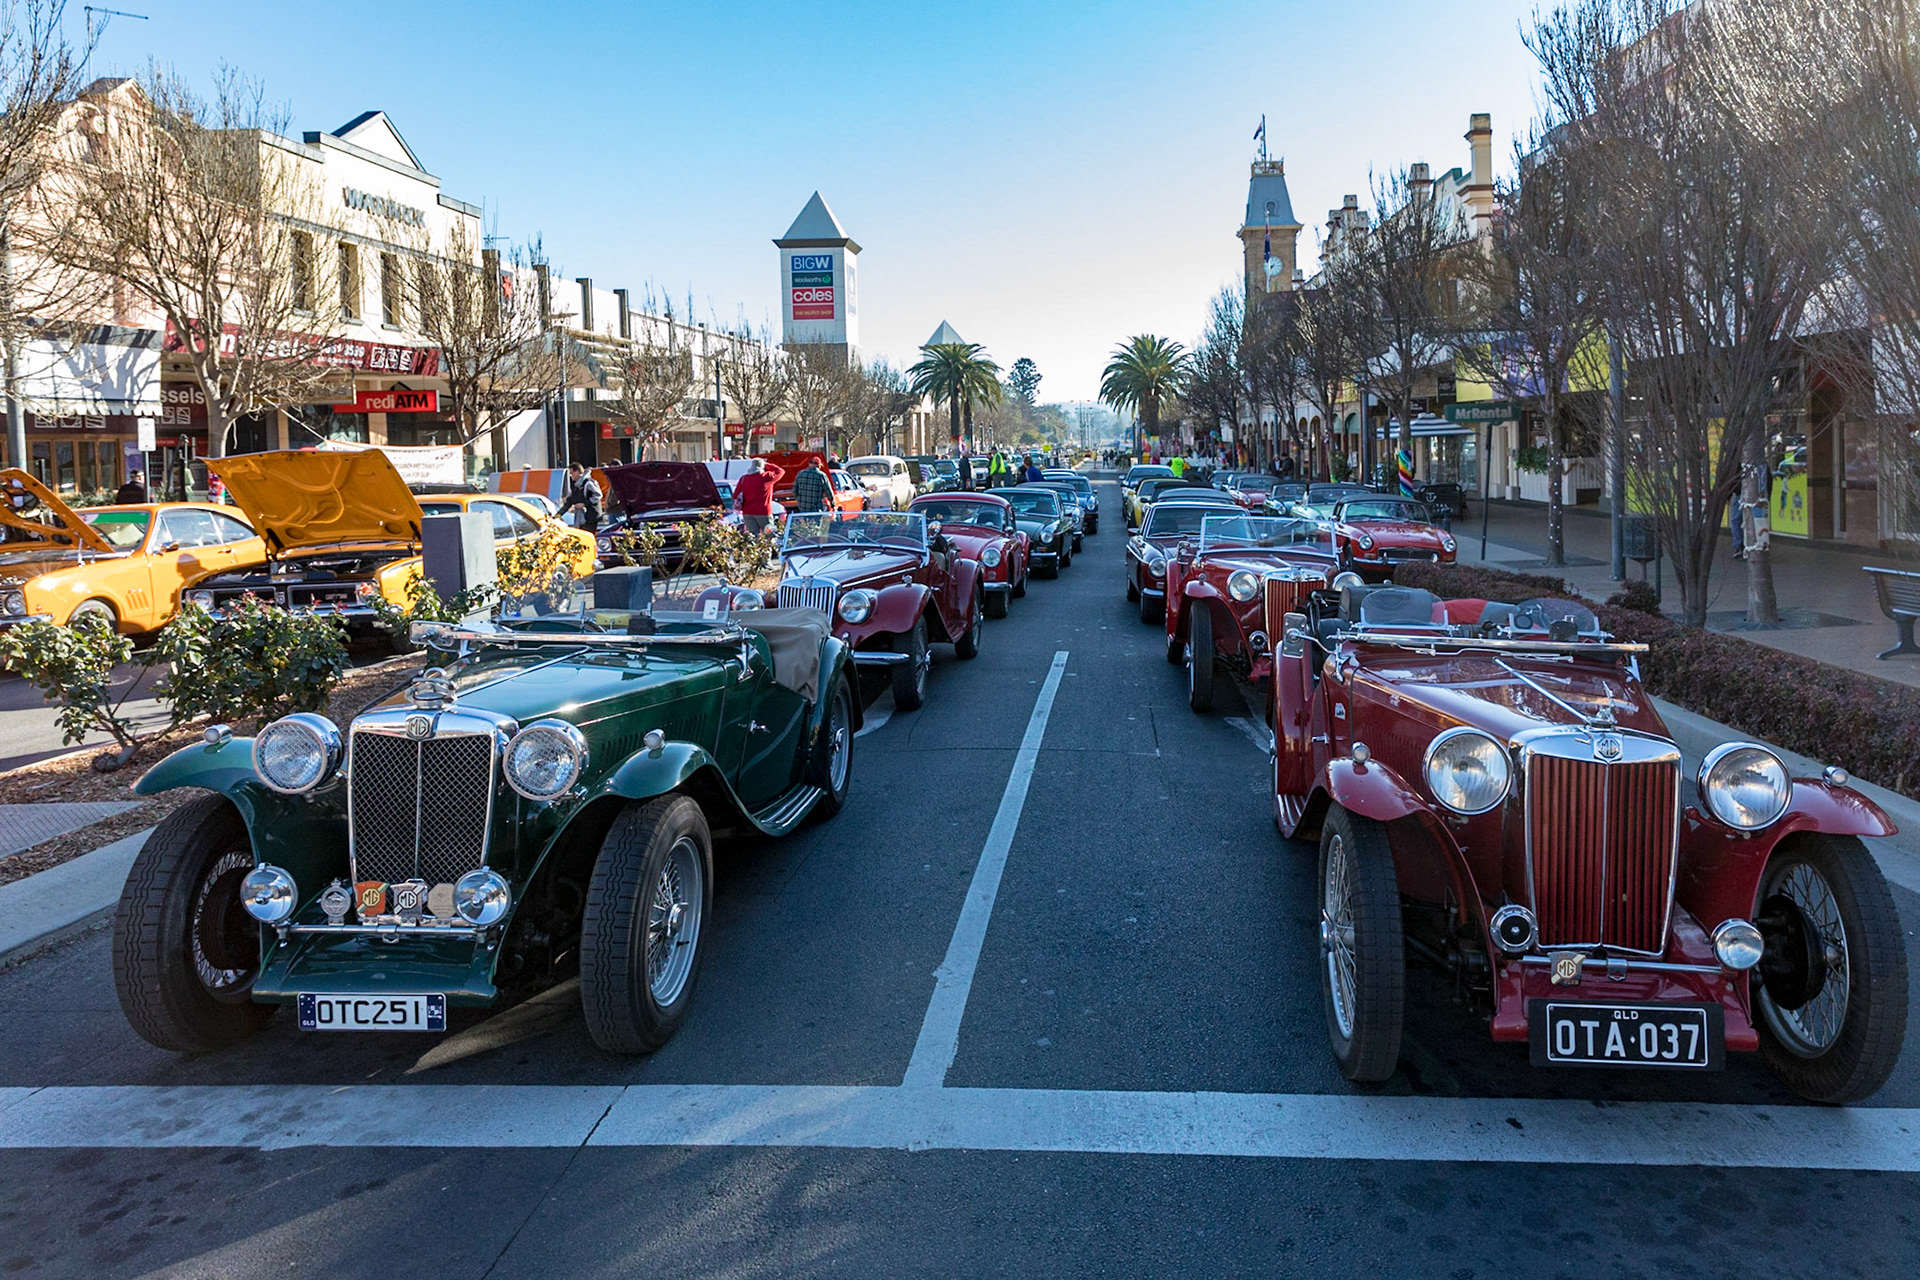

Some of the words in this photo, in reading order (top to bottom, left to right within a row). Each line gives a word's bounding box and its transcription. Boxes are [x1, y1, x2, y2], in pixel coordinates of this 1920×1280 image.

[793, 288, 833, 302] coles
[365, 394, 429, 409] rediATM
[410, 718, 428, 736] MG
[1600, 739, 1618, 756] MG
[364, 890, 378, 904] MG
[400, 892, 415, 907] MG
[1559, 961, 1575, 976] MG
[317, 1000, 419, 1024] OTC251
[1613, 1010, 1639, 1020] QLD
